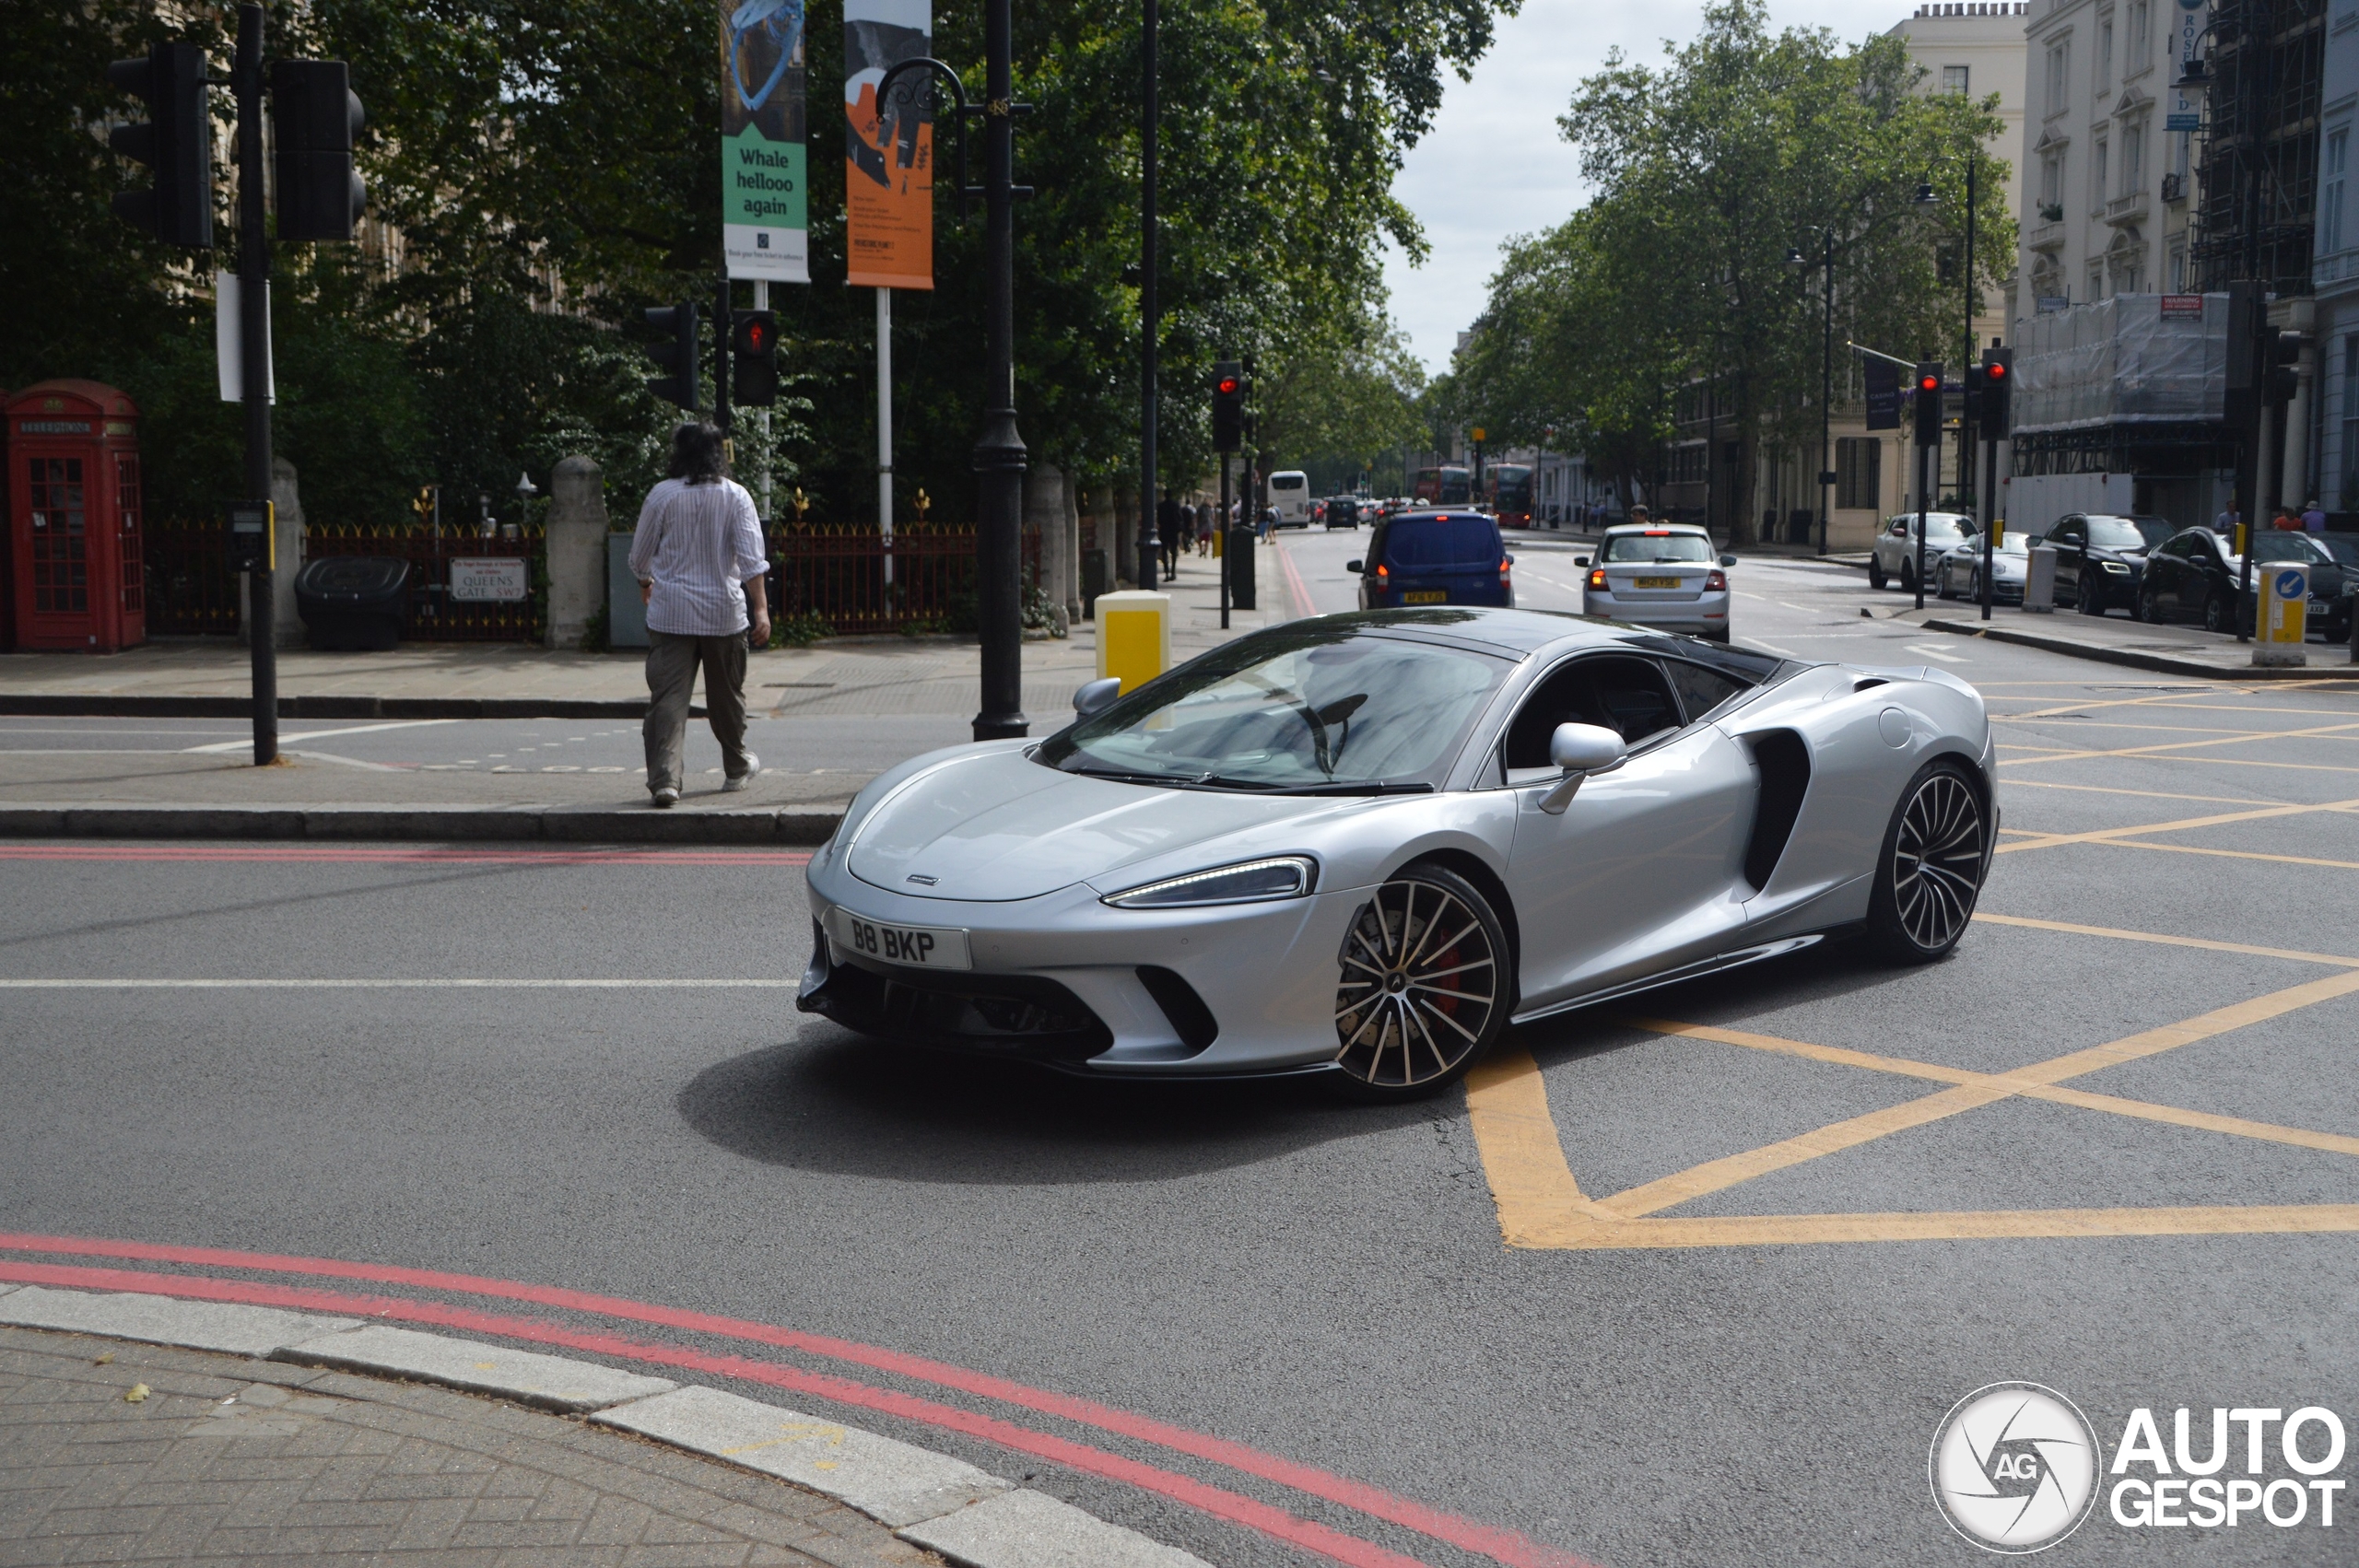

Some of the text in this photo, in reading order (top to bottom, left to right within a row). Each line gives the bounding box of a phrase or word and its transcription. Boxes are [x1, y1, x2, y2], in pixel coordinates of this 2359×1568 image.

[740, 148, 789, 169] Whale
[736, 170, 793, 192] hellooo
[744, 196, 787, 217] again
[1870, 391, 1895, 400] CASINO
[20, 422, 91, 434] TELEPHONE
[463, 576, 514, 587] QUEENS
[1660, 577, 1675, 586] VSE
[457, 588, 522, 597] GATE SW7
[851, 919, 934, 962] B8 BKP
